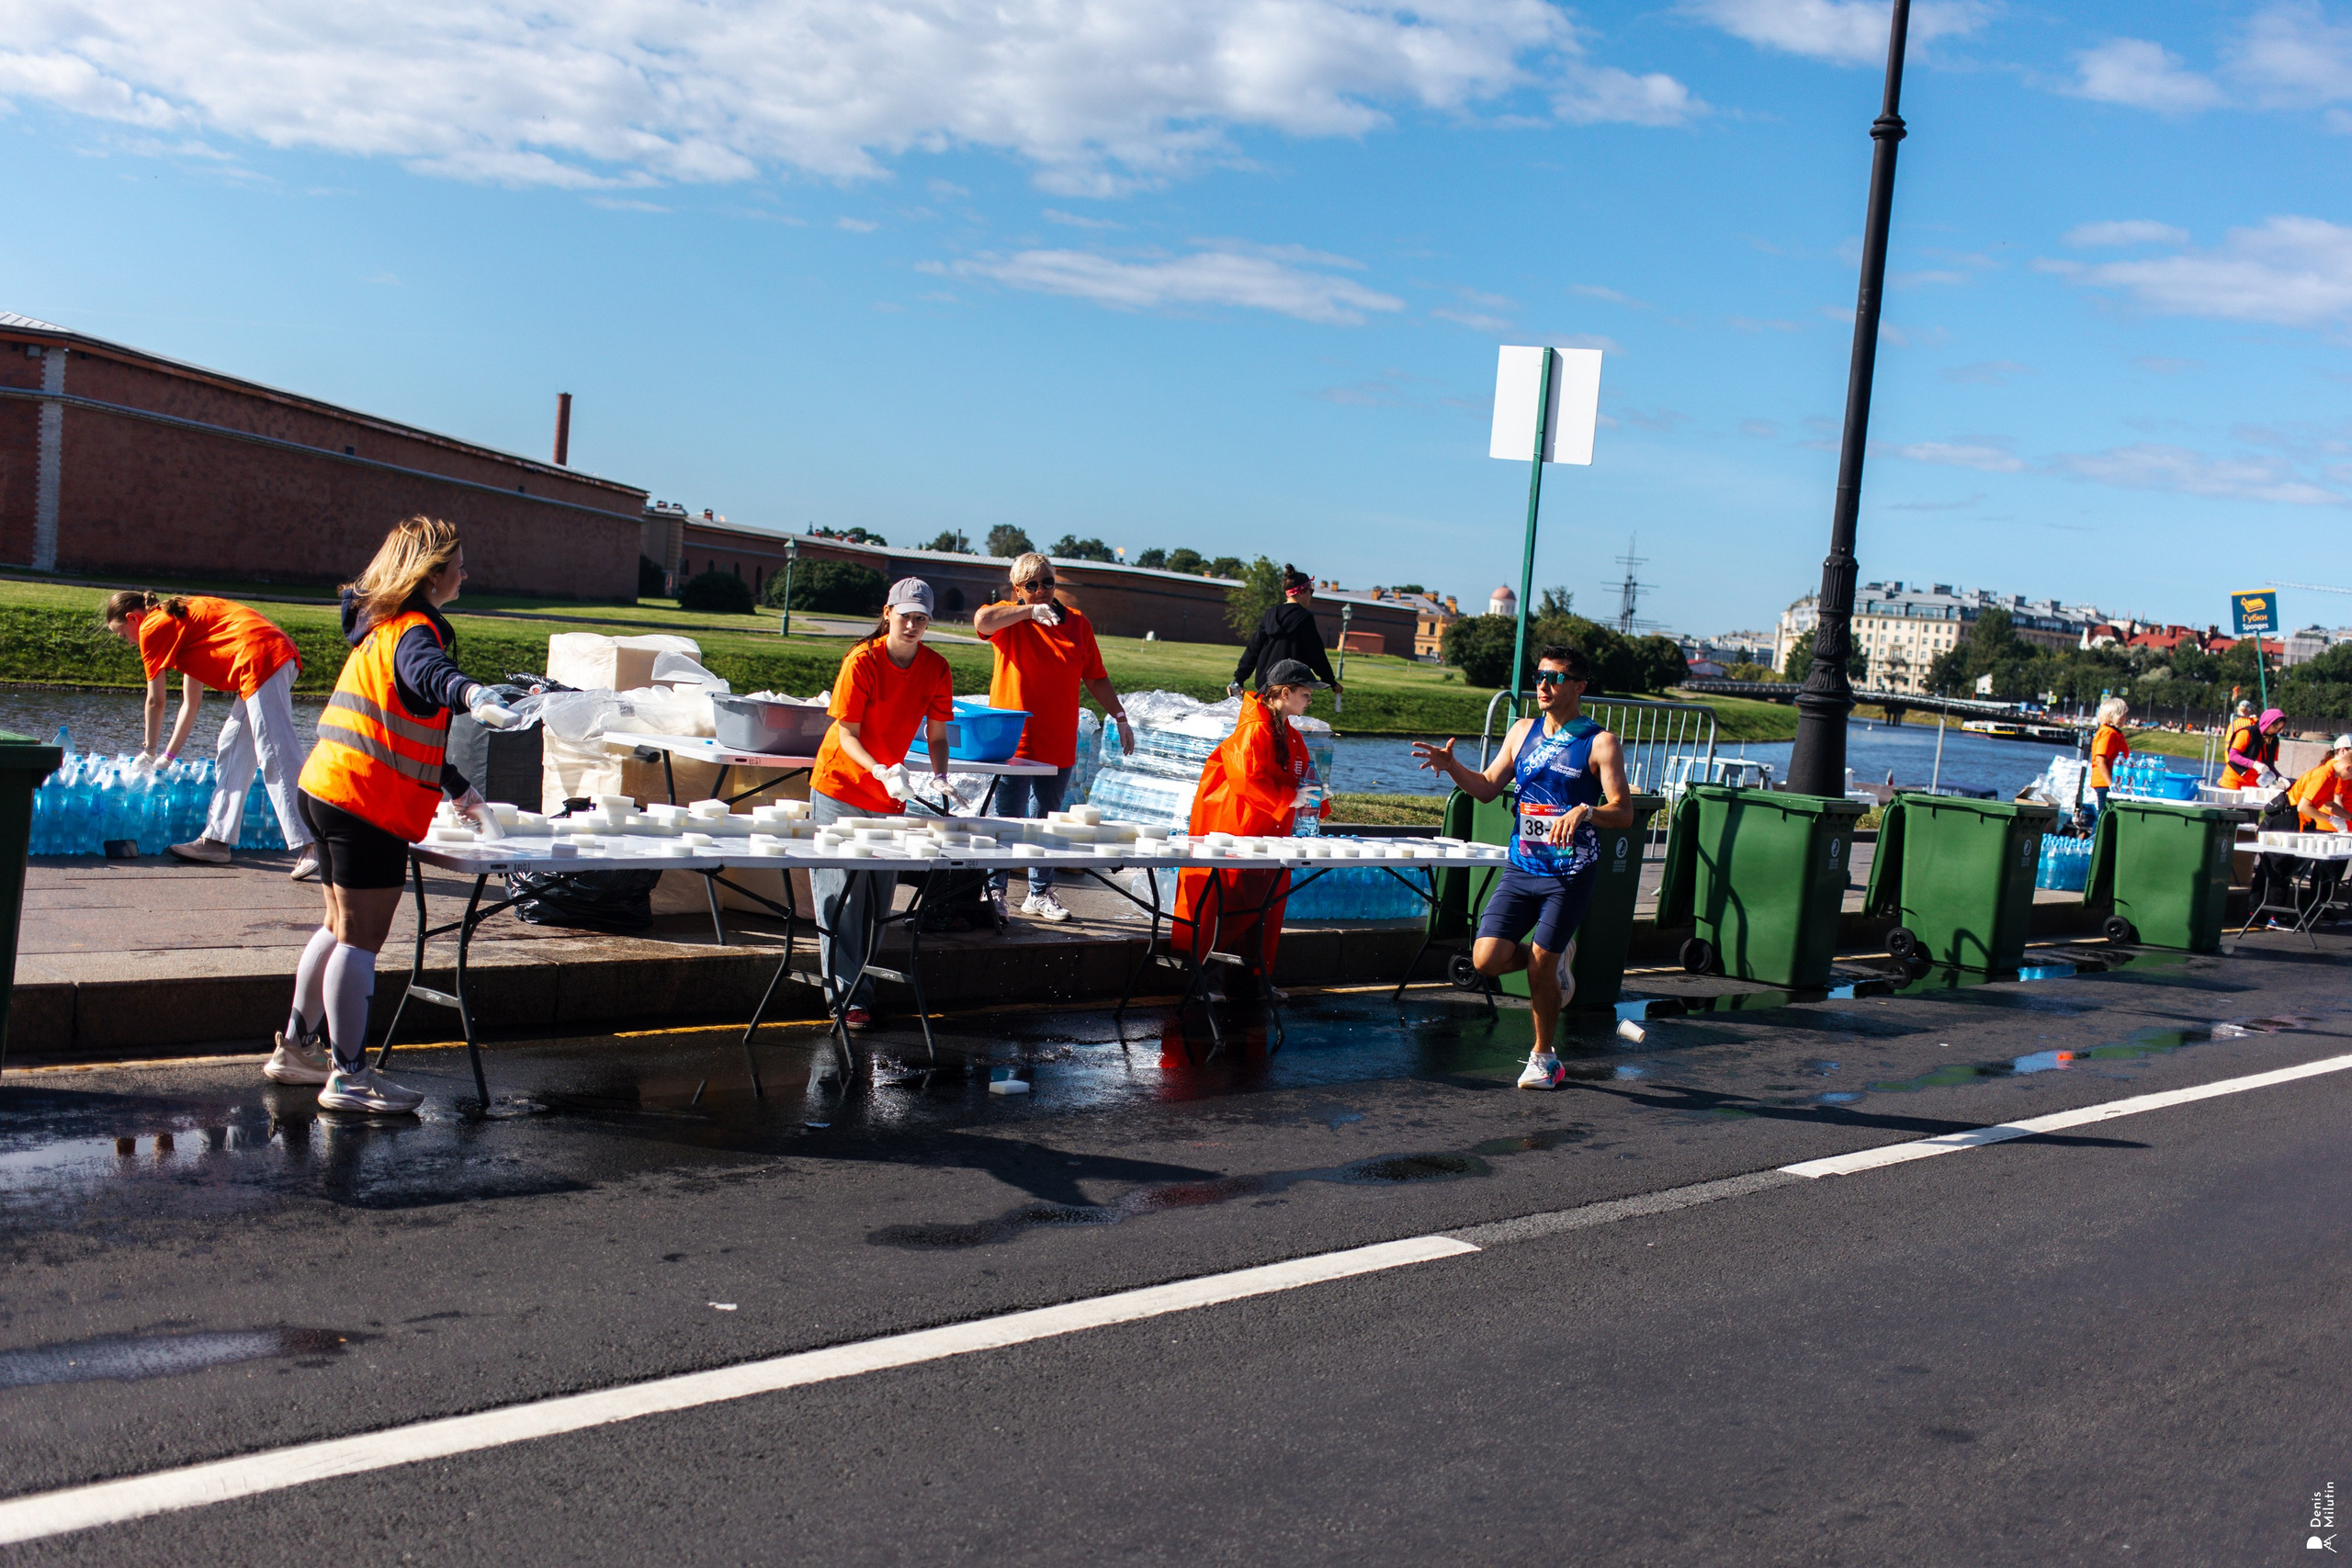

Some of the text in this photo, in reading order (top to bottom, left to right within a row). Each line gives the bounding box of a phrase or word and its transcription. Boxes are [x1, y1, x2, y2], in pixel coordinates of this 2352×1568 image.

[2243, 614, 2267, 624] Губки
[2243, 623, 2269, 631] Sponges
[1525, 819, 1551, 837] 38-
